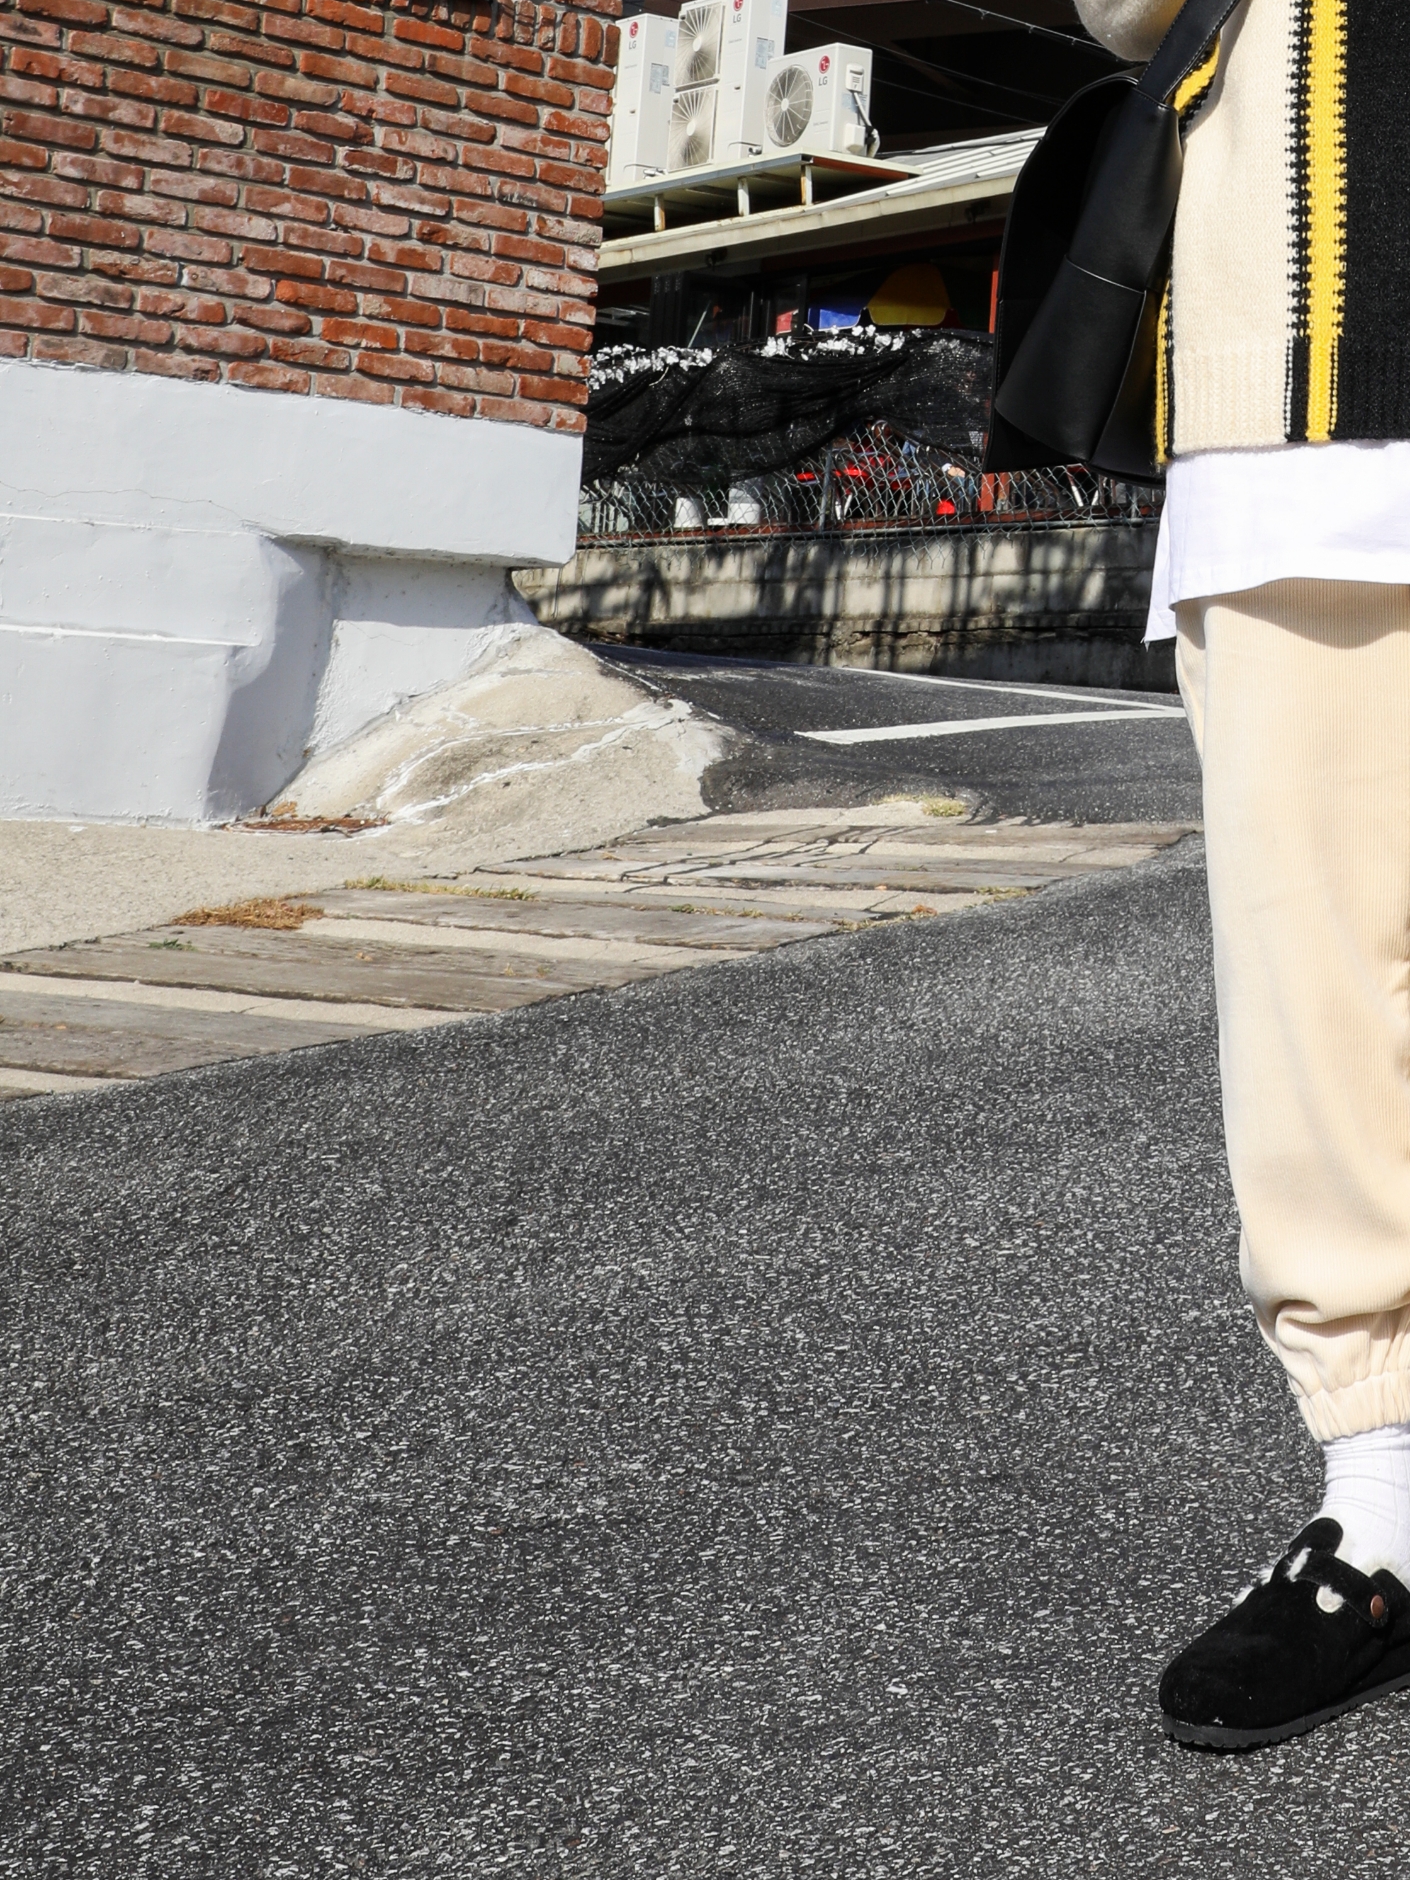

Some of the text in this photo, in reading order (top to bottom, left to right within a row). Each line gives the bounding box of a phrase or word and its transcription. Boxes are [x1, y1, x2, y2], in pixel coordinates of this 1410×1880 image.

[732, 13, 742, 24] LG
[628, 40, 637, 50] LG
[818, 76, 828, 86] LG
